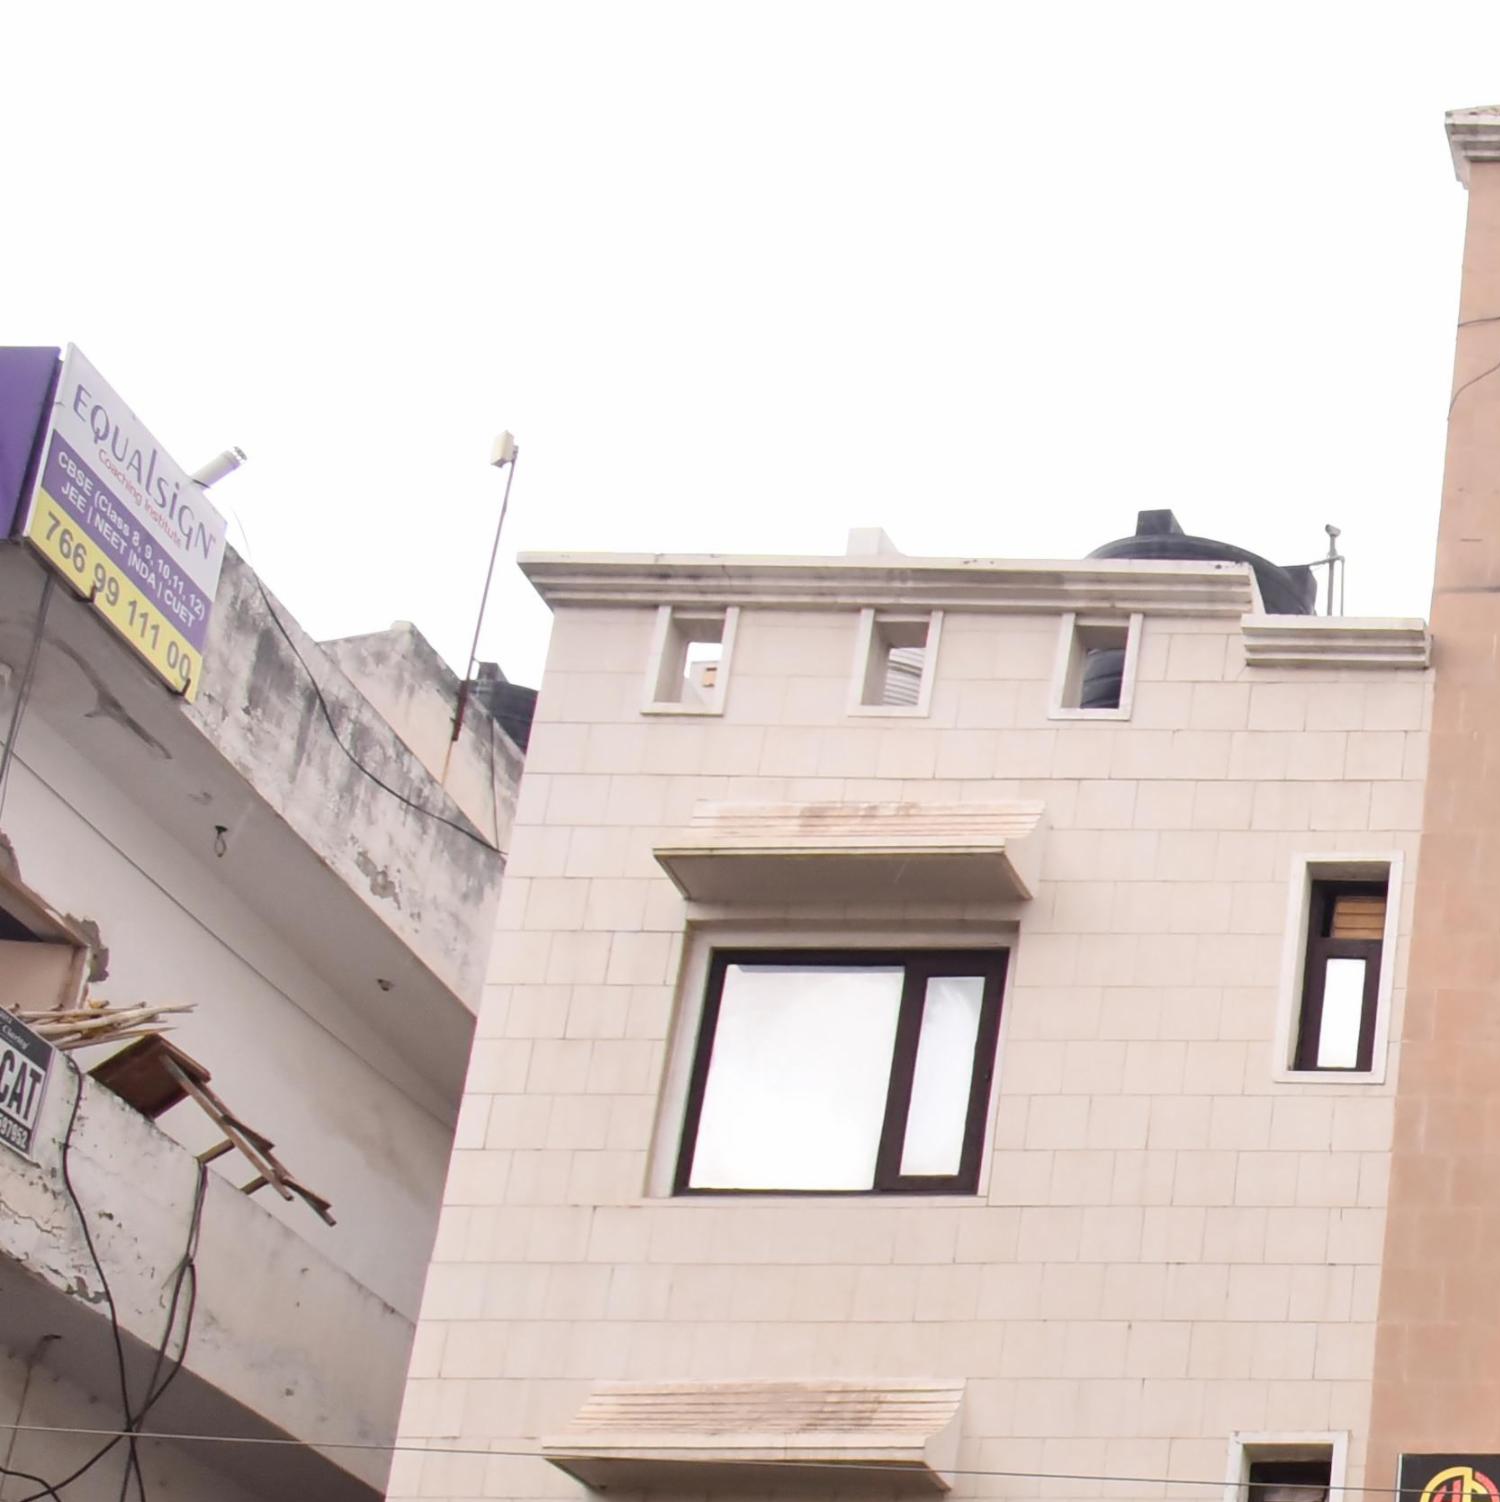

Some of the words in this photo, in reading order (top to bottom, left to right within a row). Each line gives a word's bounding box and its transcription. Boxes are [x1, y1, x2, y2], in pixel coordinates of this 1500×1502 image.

[58, 451, 94, 496] CBSE
[94, 490, 130, 537] (Class
[61, 482, 87, 513] JEE
[95, 517, 127, 554] NEET
[165, 590, 197, 628] CUET
[98, 449, 142, 507] Coaching
[144, 498, 182, 548] Institute
[46, 512, 87, 573] 766
[93, 563, 120, 607] 99
[128, 600, 160, 650] 111
[167, 641, 191, 681] 00
